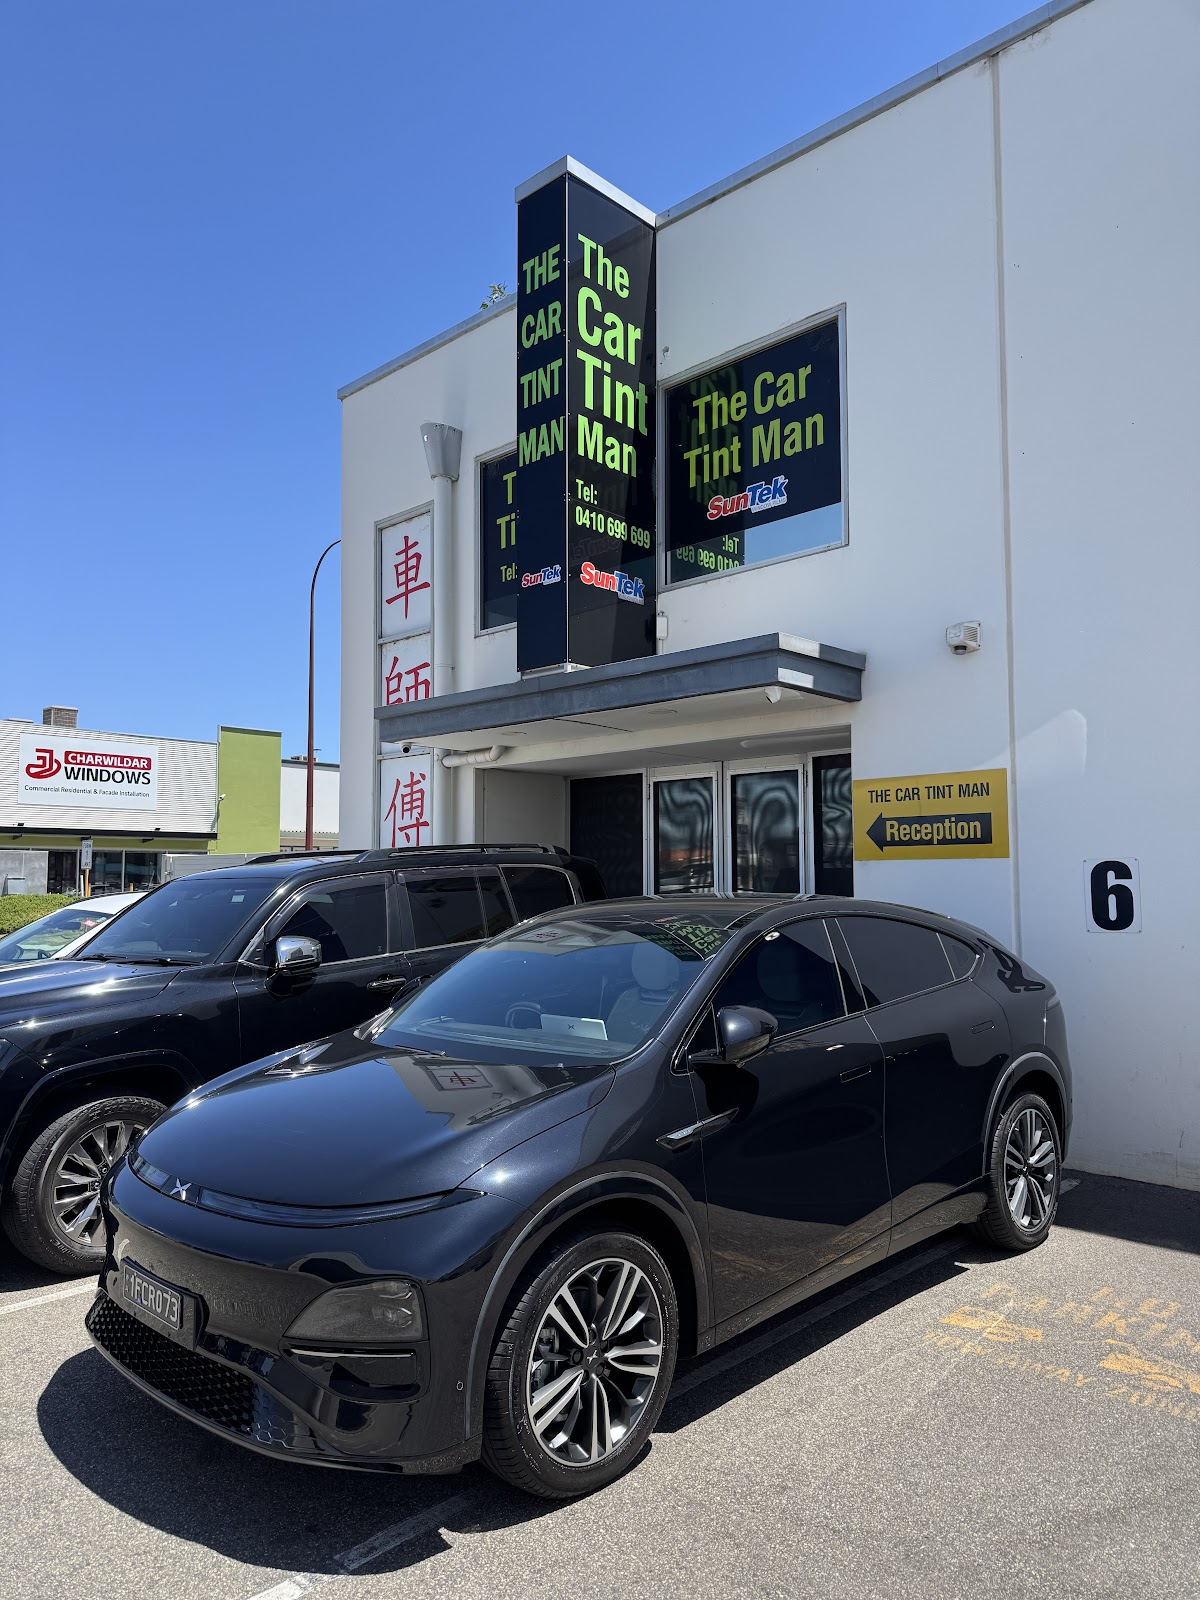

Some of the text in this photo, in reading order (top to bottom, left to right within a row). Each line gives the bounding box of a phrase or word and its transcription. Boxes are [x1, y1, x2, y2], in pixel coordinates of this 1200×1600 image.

[522, 243, 561, 295] THE
[577, 232, 630, 299] The
[521, 300, 562, 349] CAR
[577, 286, 641, 366] Car
[520, 358, 563, 409] TINT
[576, 348, 648, 437] Tint
[692, 363, 812, 435] The Car
[518, 415, 564, 467] MAN
[577, 414, 637, 478] Man
[683, 412, 824, 488] Tint Man
[575, 479, 598, 505] Tel:
[707, 475, 788, 520] SunTek
[496, 512, 516, 549] Ti
[575, 506, 651, 549] 0410 699 699
[522, 565, 561, 588] SunTek
[580, 561, 645, 599] SunTek
[64, 766, 151, 785] WINDOWS
[68, 753, 148, 769] CHARWILDAR
[24, 784, 60, 792] Commercial
[61, 786, 92, 794] Residential
[119, 790, 150, 798] Installation
[868, 782, 990, 804] THE CAR TINT MAN
[885, 817, 982, 844] Reception
[1090, 860, 1134, 931] 6
[130, 1275, 178, 1322] 1FCR073
